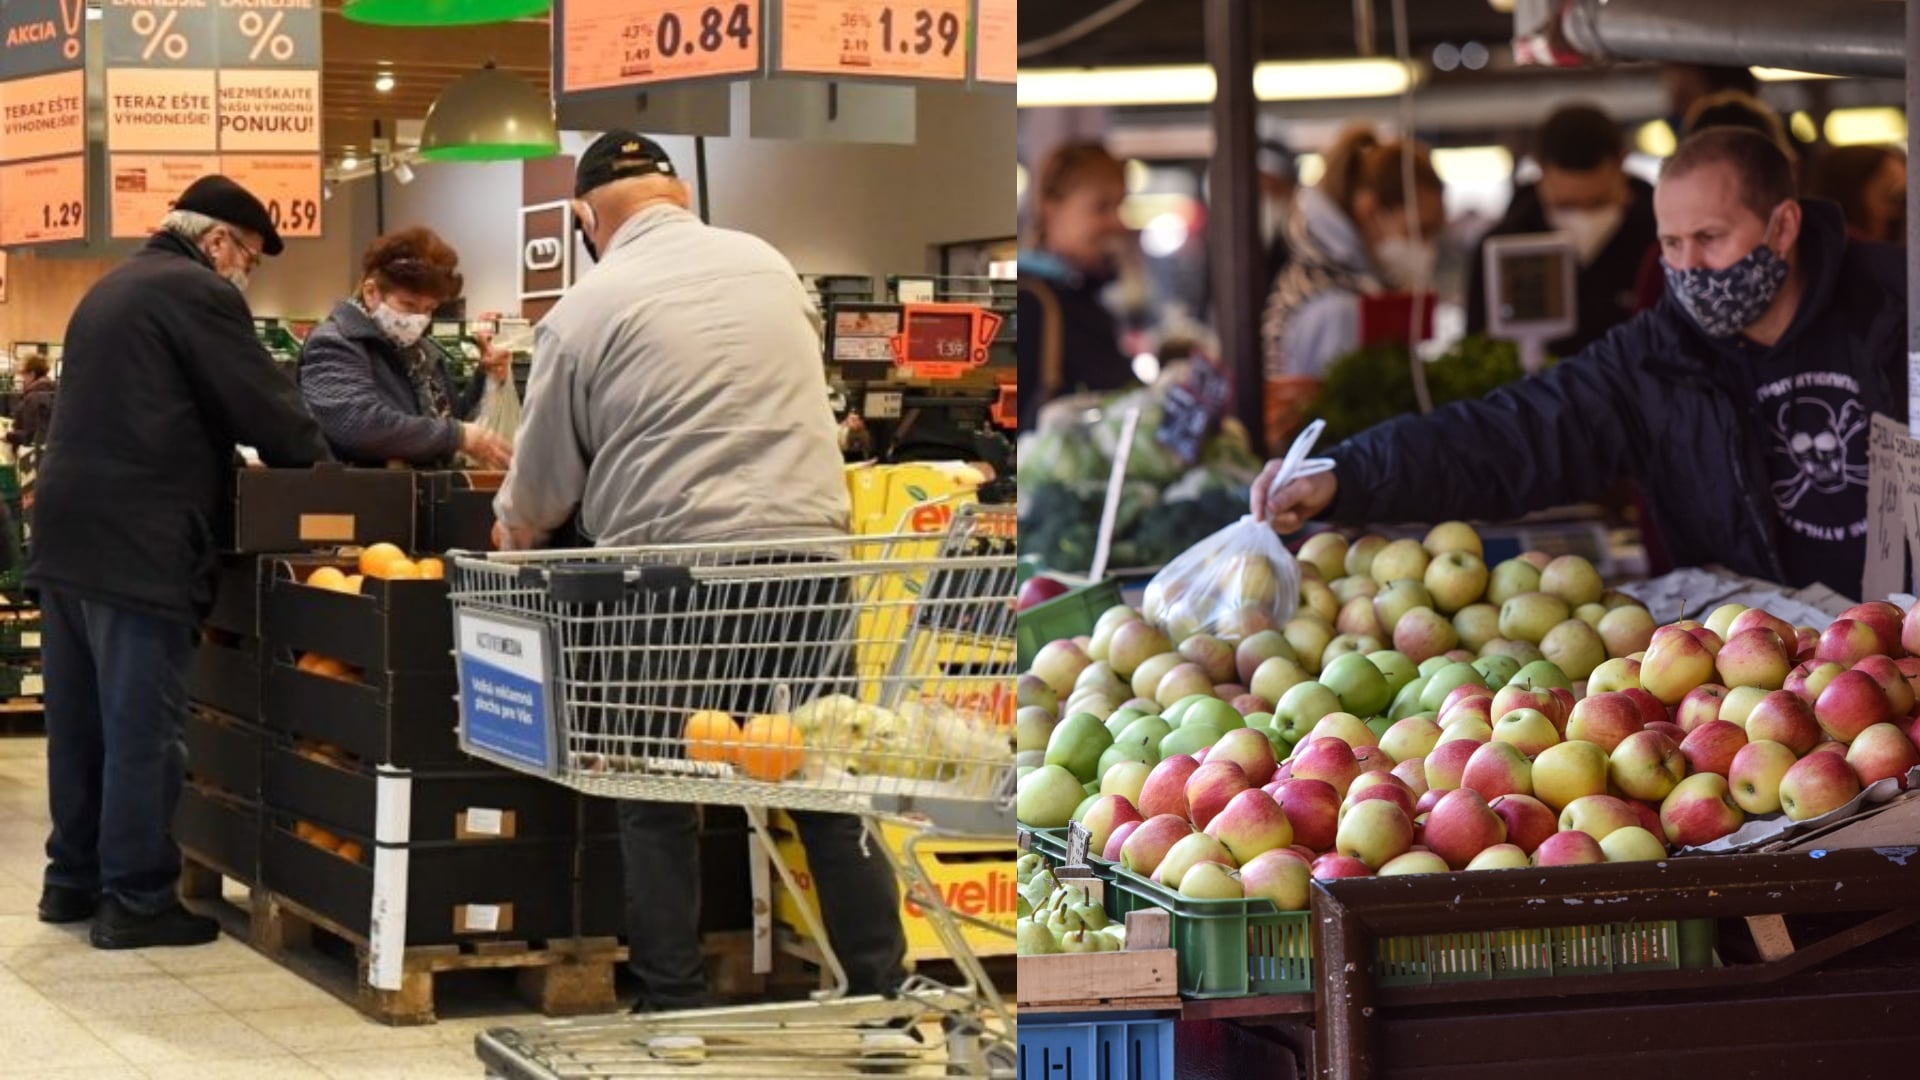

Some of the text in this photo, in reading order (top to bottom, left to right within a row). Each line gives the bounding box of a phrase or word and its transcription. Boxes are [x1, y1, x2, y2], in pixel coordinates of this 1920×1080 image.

[6, 21, 57, 48] AKCIA
[657, 3, 752, 58] 0.84
[879, 6, 960, 57] 1.39
[114, 92, 210, 110] TERAZ EŠTE
[219, 86, 313, 100] NEZMEŠKAJTE
[4, 96, 80, 119] TERAZ EŠTE
[219, 115, 314, 133] PONUKU!
[43, 201, 82, 229] 1.29
[269, 199, 317, 230] 0.59
